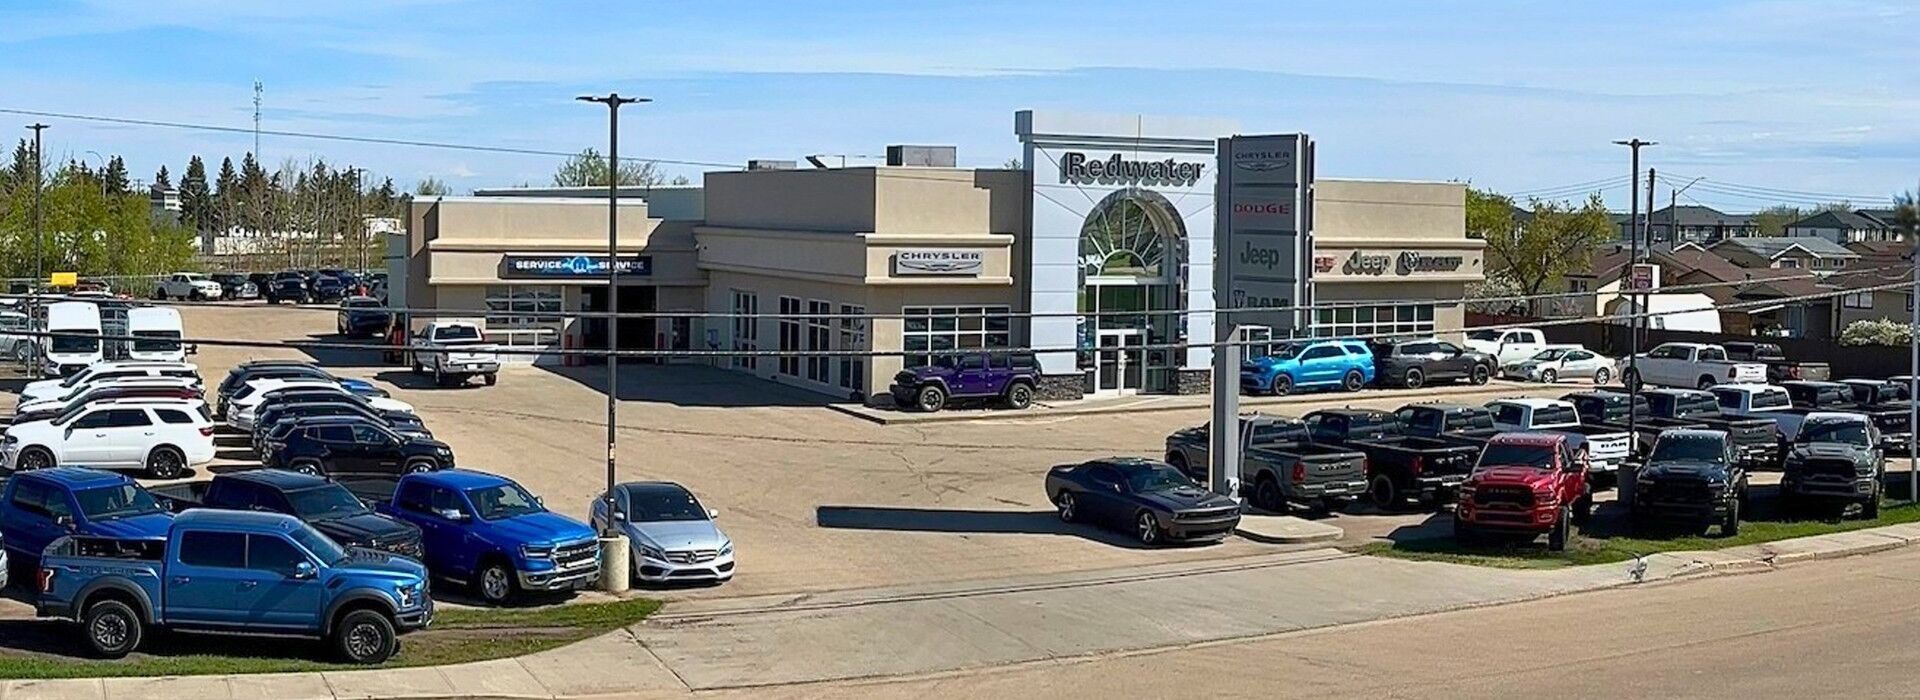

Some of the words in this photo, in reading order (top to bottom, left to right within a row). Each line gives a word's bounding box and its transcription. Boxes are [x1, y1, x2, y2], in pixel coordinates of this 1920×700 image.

[1234, 151, 1290, 159] CHRYSLER
[1065, 151, 1205, 182] Redwater
[1233, 203, 1291, 214] DODGE
[901, 252, 979, 260] CHRYSLER
[1240, 240, 1280, 271] Jeep
[1349, 250, 1392, 272] Jeep
[515, 260, 562, 269] SERVICE
[1247, 296, 1289, 308] RAM
